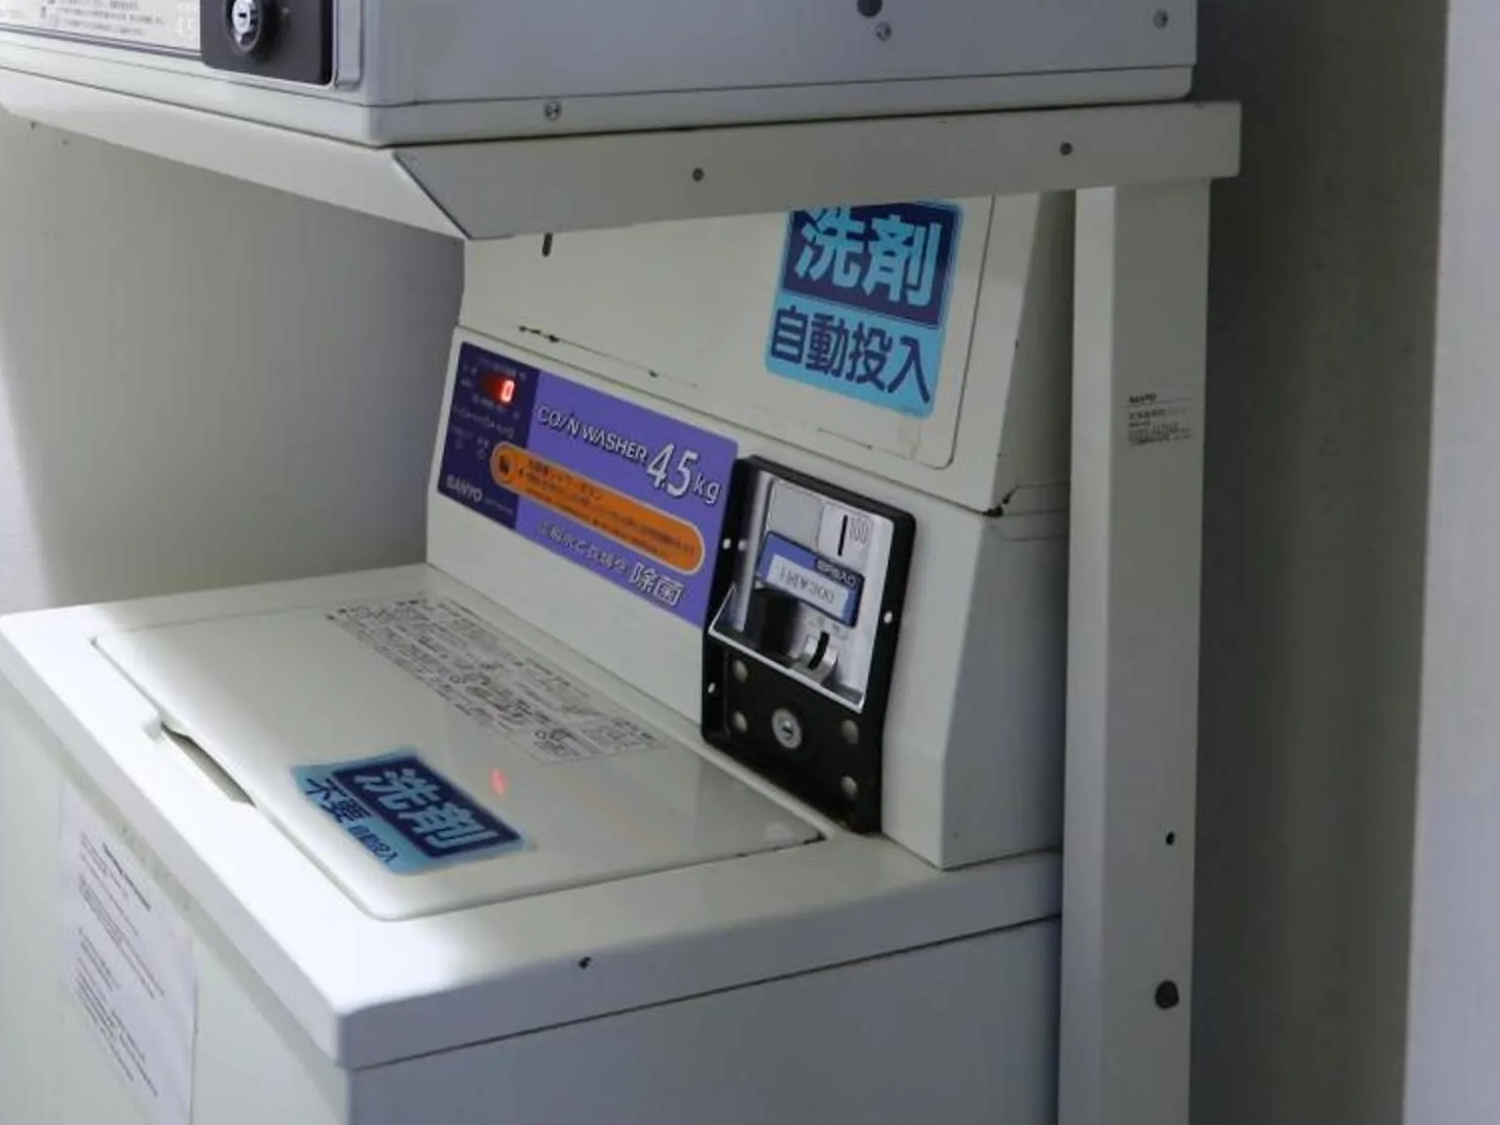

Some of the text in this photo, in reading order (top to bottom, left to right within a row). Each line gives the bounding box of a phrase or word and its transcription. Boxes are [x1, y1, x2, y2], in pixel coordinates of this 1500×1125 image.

[794, 206, 943, 307] 洗剤
[771, 304, 931, 404] 自動投入
[581, 426, 647, 463] WASHER
[354, 768, 500, 849] 洗剤
